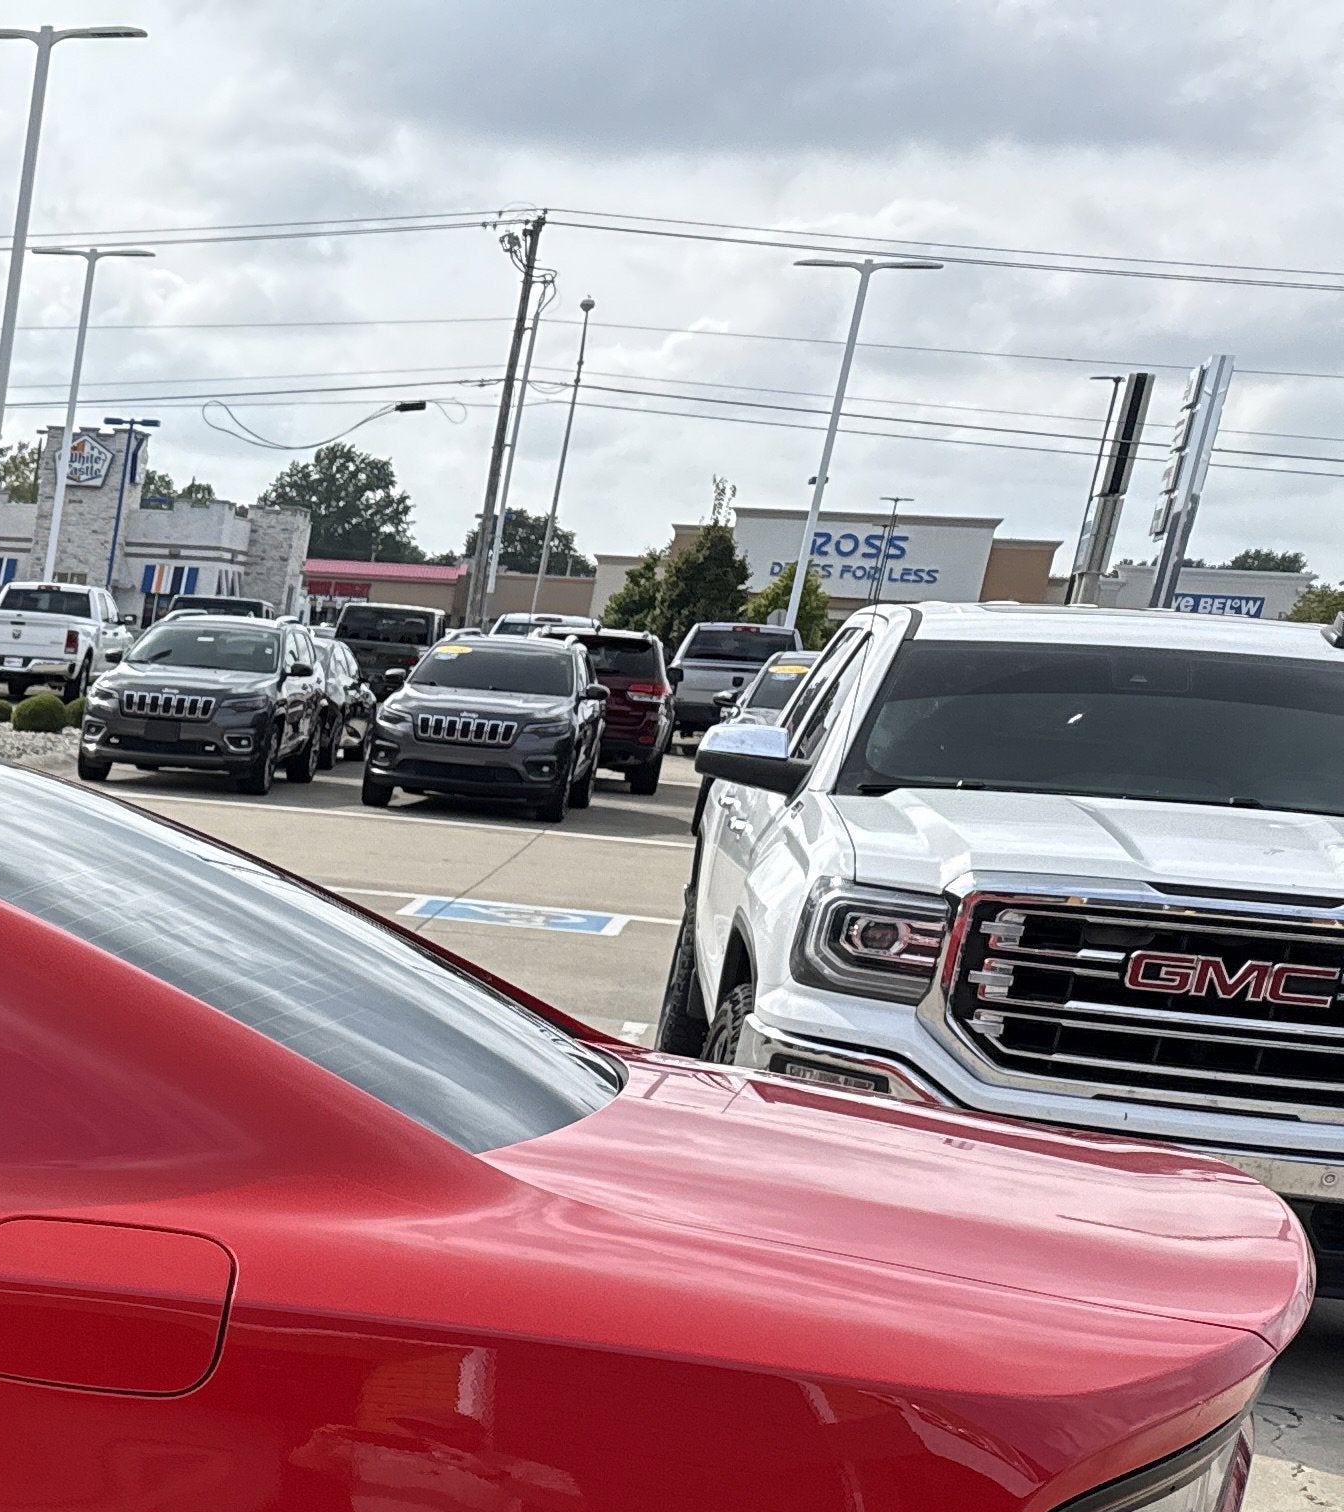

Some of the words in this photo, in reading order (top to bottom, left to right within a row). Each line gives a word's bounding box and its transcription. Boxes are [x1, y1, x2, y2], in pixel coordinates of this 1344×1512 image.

[68, 463, 102, 477] astle
[810, 532, 909, 559] ROSS
[840, 565, 881, 581] FOR
[888, 568, 940, 584] LESS
[1198, 597, 1261, 615] BELOW
[1125, 950, 1340, 1008] GMC
